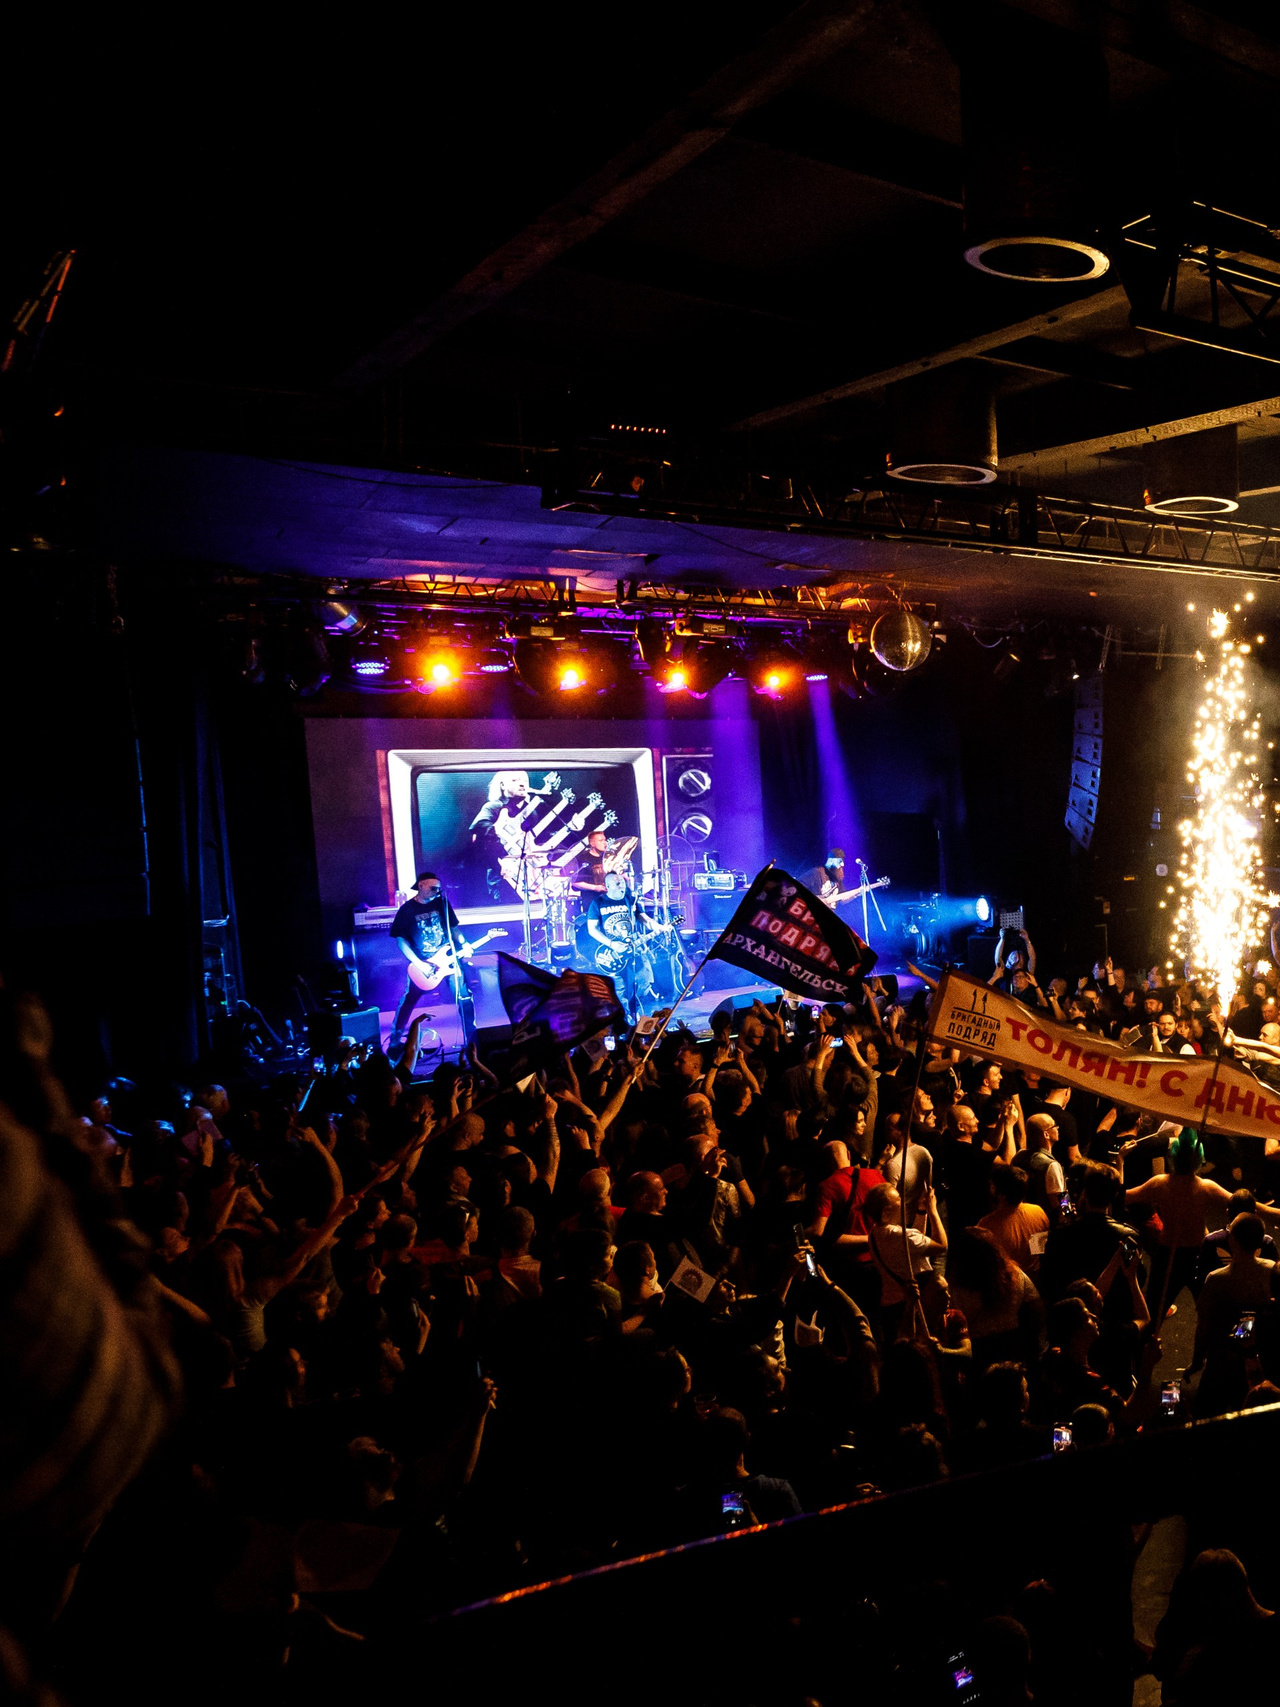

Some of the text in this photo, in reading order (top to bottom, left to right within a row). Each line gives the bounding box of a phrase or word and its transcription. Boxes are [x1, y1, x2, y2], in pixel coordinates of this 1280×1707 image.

[721, 932, 849, 997] АРХАНГЕЛЬСК
[948, 1022, 996, 1047] ПОДРЯД
[951, 1010, 1000, 1031] БРИГАДНЫЙ
[1006, 1016, 1151, 1089] ТОЛЯН!
[1160, 1069, 1188, 1097] С
